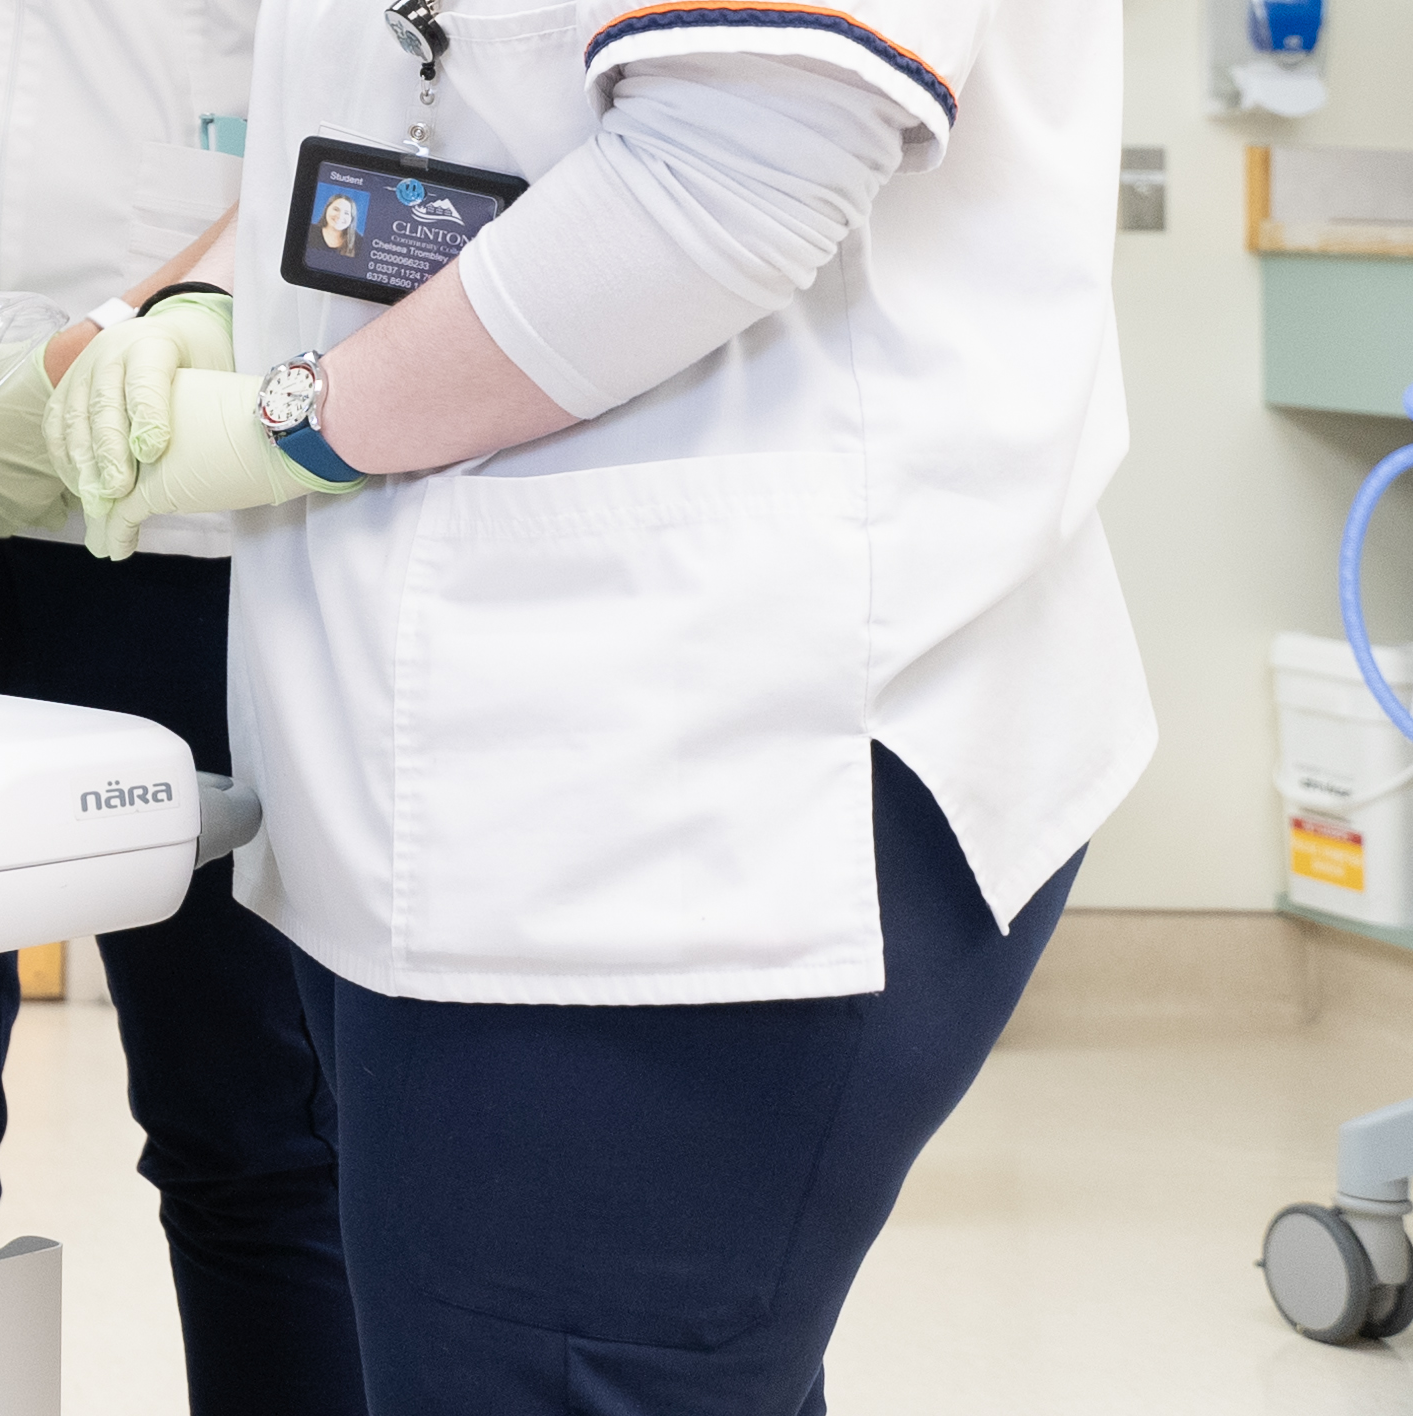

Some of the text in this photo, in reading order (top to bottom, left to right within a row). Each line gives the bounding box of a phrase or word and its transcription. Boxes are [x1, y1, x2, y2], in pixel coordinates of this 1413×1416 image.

[329, 170, 364, 186] Student
[392, 220, 472, 246] CLINTON
[391, 235, 439, 251] Community
[372, 239, 449, 264] Chelsea Trombley
[400, 268, 421, 280] 1124
